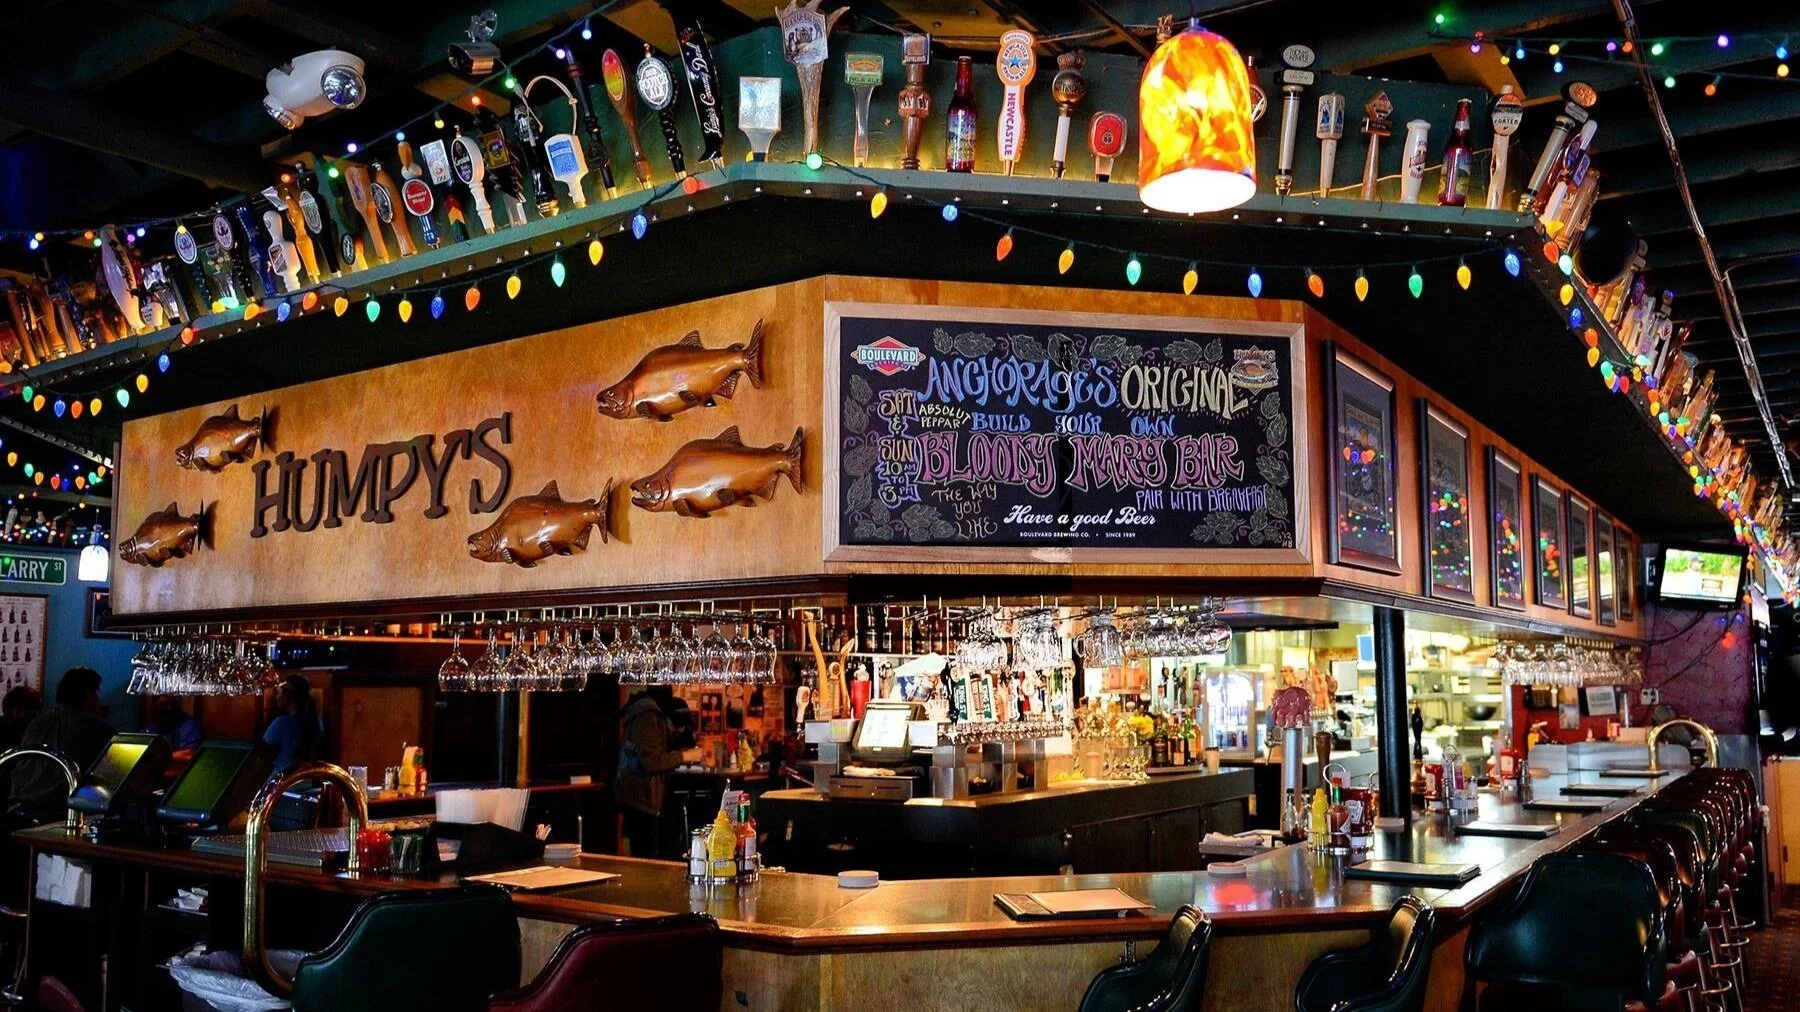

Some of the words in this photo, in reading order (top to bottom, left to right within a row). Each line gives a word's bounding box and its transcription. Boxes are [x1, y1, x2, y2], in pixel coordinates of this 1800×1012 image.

[1004, 92, 1016, 156] NEWCASTLE
[861, 348, 917, 363] BOULEVARD
[881, 391, 914, 416] SAT
[1121, 363, 1249, 421] ORIGINAL
[919, 403, 972, 425] ABSOLUT
[921, 416, 961, 429] PEPPAR
[971, 411, 1031, 432] BUILD
[1131, 415, 1176, 436] OWN
[881, 438, 914, 463] SUN
[250, 411, 512, 539] HUMPY'S
[883, 461, 903, 476] 10
[918, 431, 1057, 497] BLOODY
[1064, 435, 1167, 491] MARY
[1170, 433, 1245, 489] BAR
[891, 476, 905, 484] TO
[931, 487, 963, 502] THE
[967, 481, 998, 500] WAY
[883, 486, 897, 502] 3
[1135, 489, 1164, 512] PAIR
[1170, 490, 1203, 512] WITH
[953, 500, 982, 520] YOU
[1003, 504, 1055, 524] Have
[1057, 513, 1070, 525] a
[1069, 508, 1114, 532] good
[1115, 506, 1157, 525] Beer
[954, 517, 999, 540] LIKE
